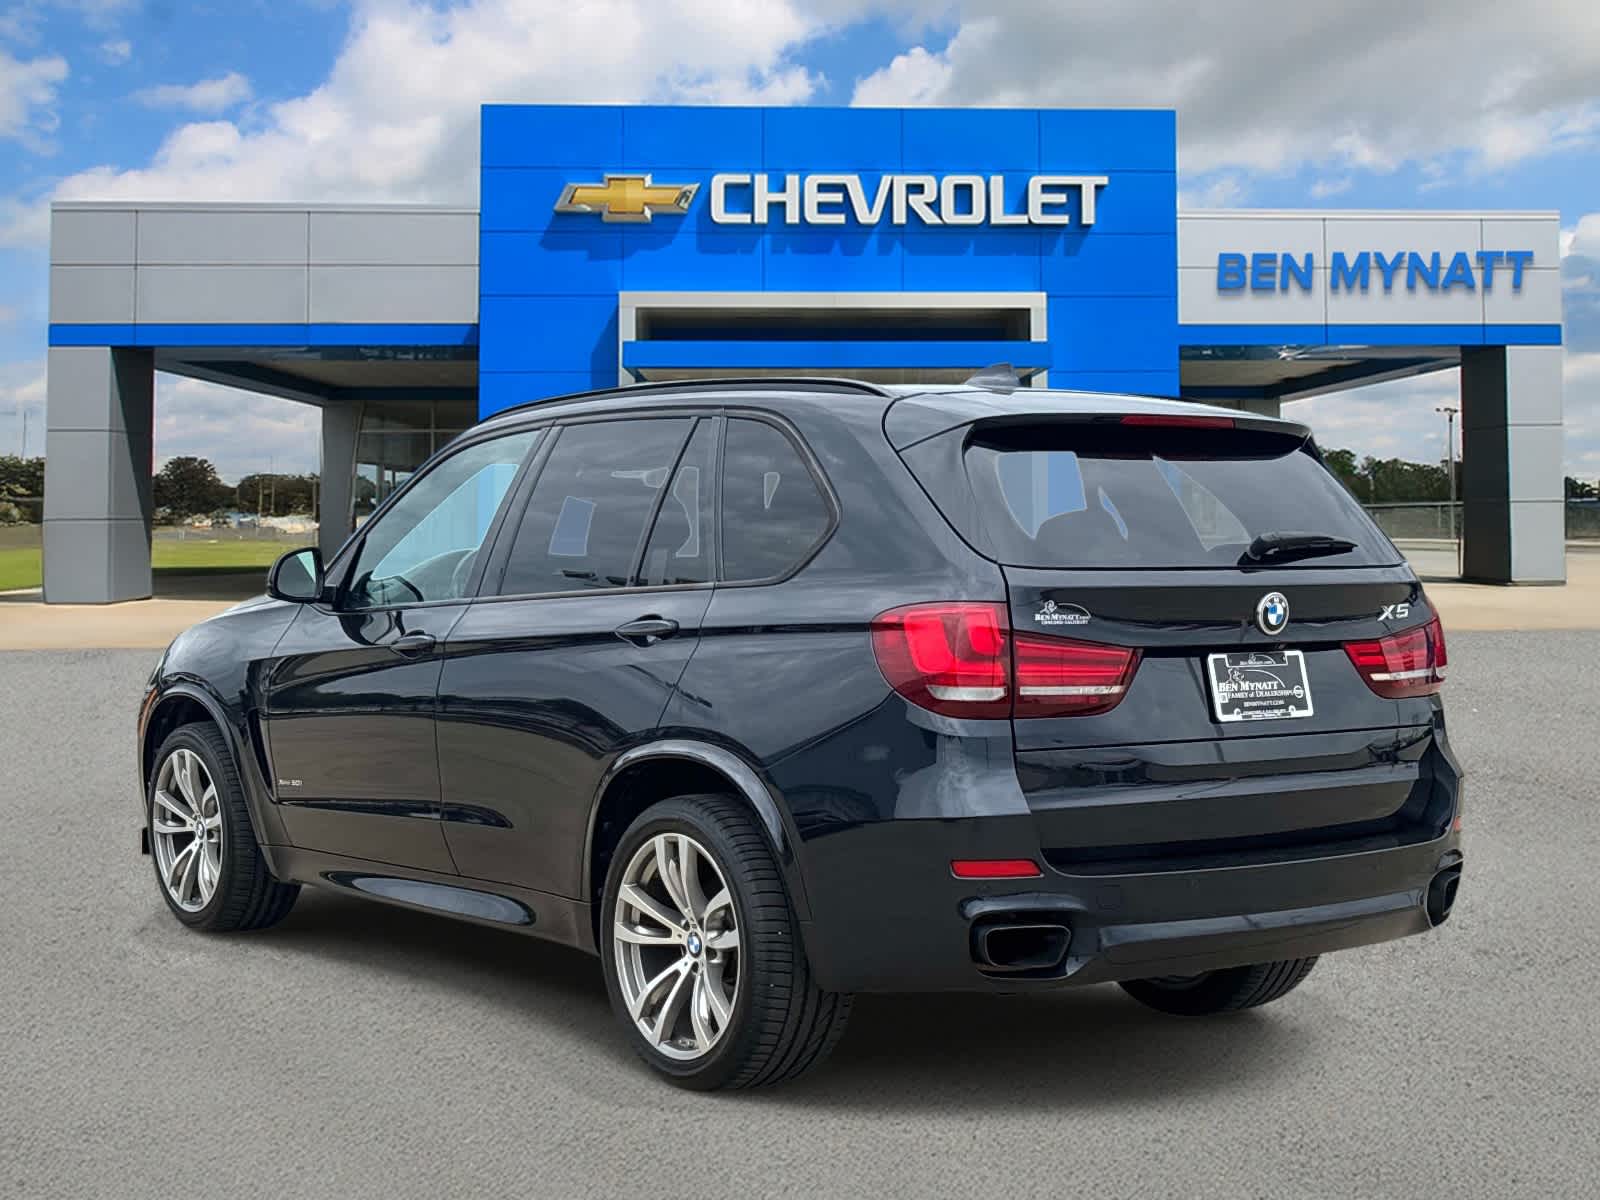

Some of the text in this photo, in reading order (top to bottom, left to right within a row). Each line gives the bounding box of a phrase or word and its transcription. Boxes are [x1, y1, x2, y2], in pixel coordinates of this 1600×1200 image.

[710, 173, 1109, 226] CHEVROLET
[1216, 250, 1535, 291] BEN MYNATT
[1377, 603, 1410, 621] X5
[1218, 680, 1279, 692] BEN MYNATT
